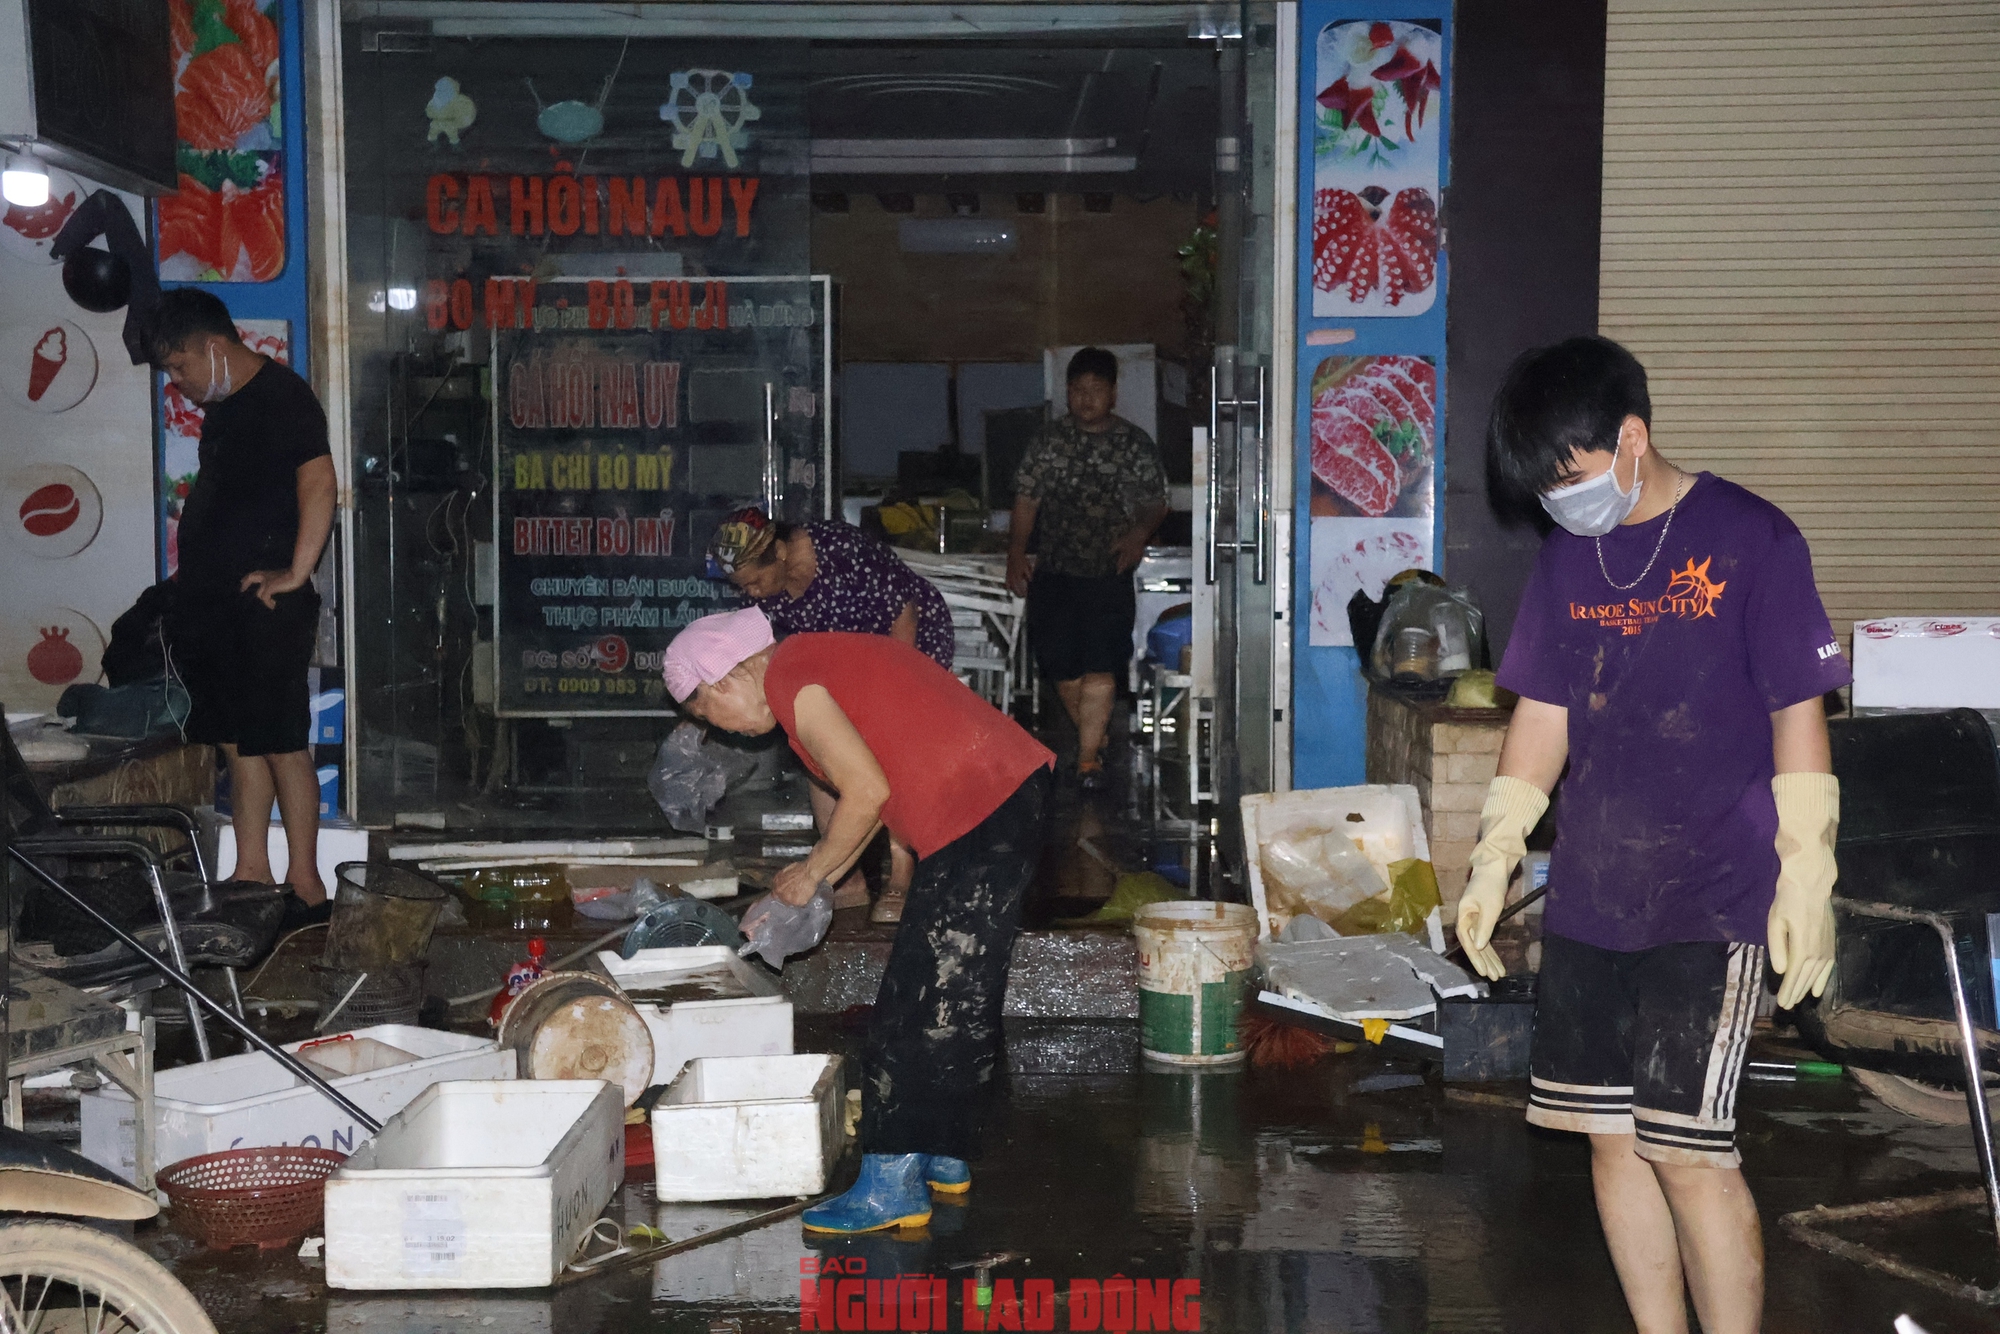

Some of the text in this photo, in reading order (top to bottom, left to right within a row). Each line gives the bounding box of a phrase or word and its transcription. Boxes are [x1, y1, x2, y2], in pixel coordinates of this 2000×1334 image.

[651, 279, 728, 331] FUJI
[643, 360, 681, 429] UY
[513, 517, 593, 555] BITTET
[530, 575, 609, 597] CHUYÊN
[612, 575, 655, 598] BÁN
[1621, 625, 1643, 636] 2015
[597, 634, 629, 673] 9
